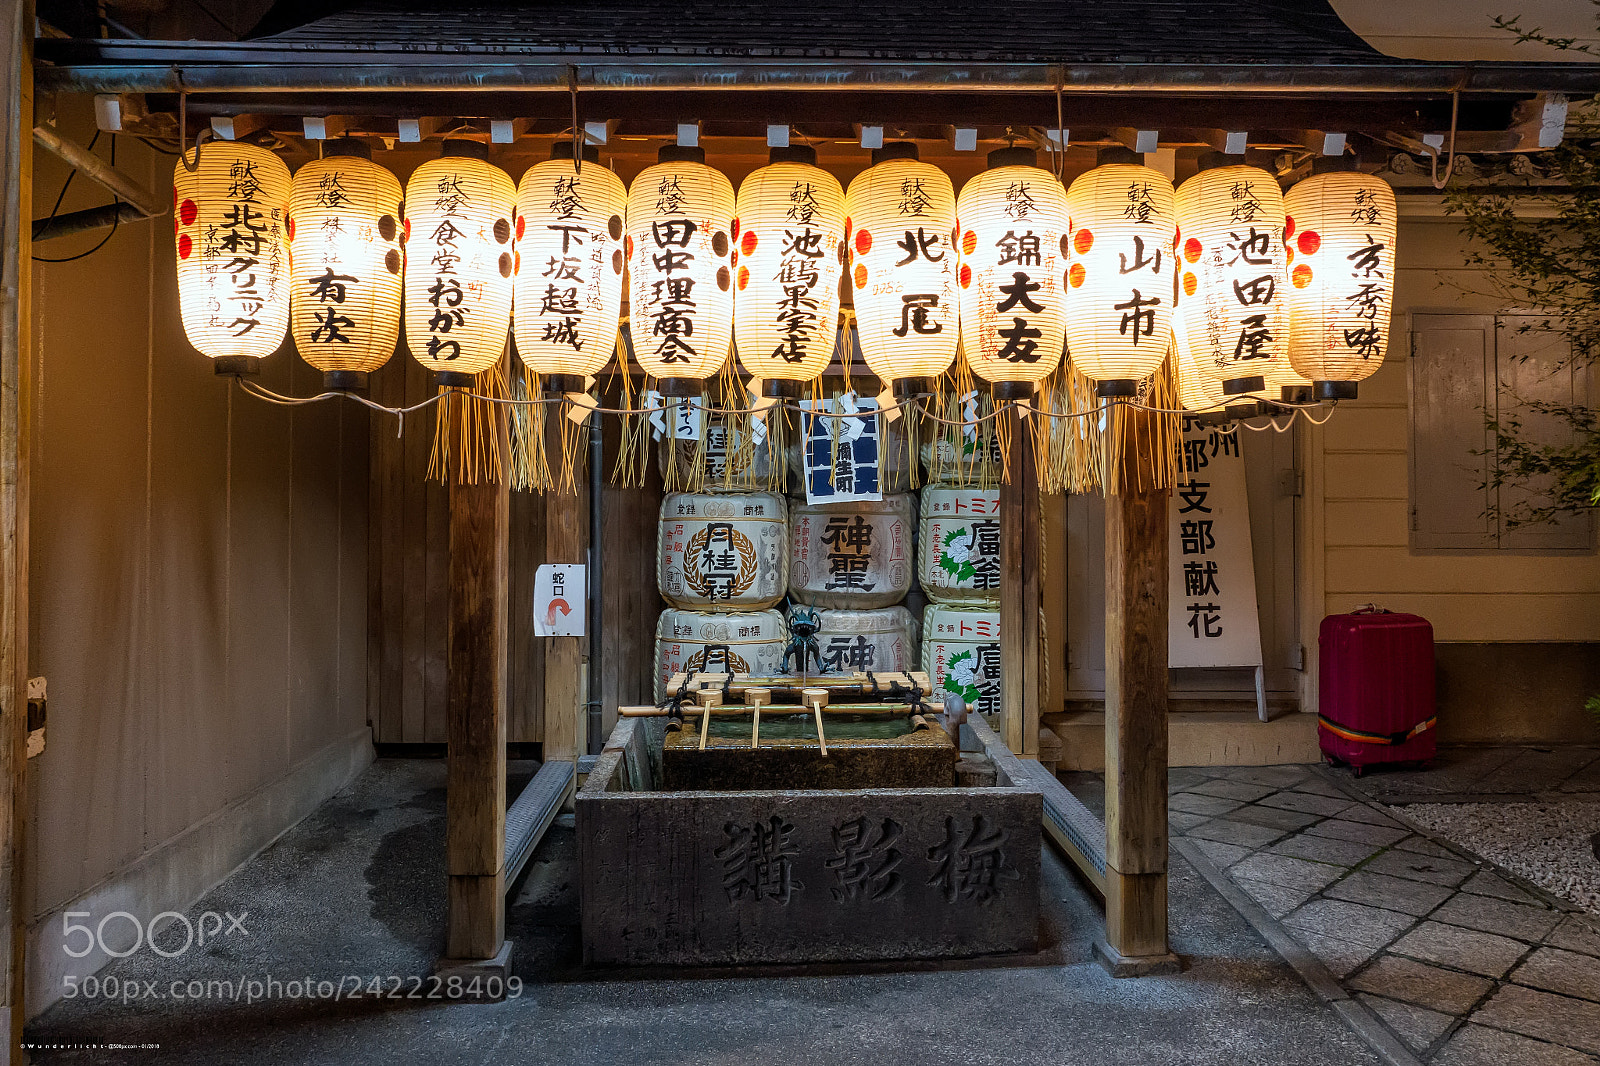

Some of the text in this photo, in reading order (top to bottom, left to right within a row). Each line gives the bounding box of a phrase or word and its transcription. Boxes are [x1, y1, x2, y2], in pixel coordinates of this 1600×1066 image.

[219, 204, 269, 337] 北村クリニック
[309, 267, 360, 344] 有次
[425, 219, 471, 361] 食堂おがわ
[772, 228, 825, 363] 池鶴果実店
[892, 227, 945, 337] 北尾
[995, 230, 1046, 363] 錦大友
[1114, 235, 1162, 347] 山市
[1226, 227, 1276, 360] 池田屋
[552, 572, 565, 597] 蛇口
[701, 522, 738, 601] 月桂冠
[820, 515, 877, 592] 神聖
[822, 635, 876, 672] 神
